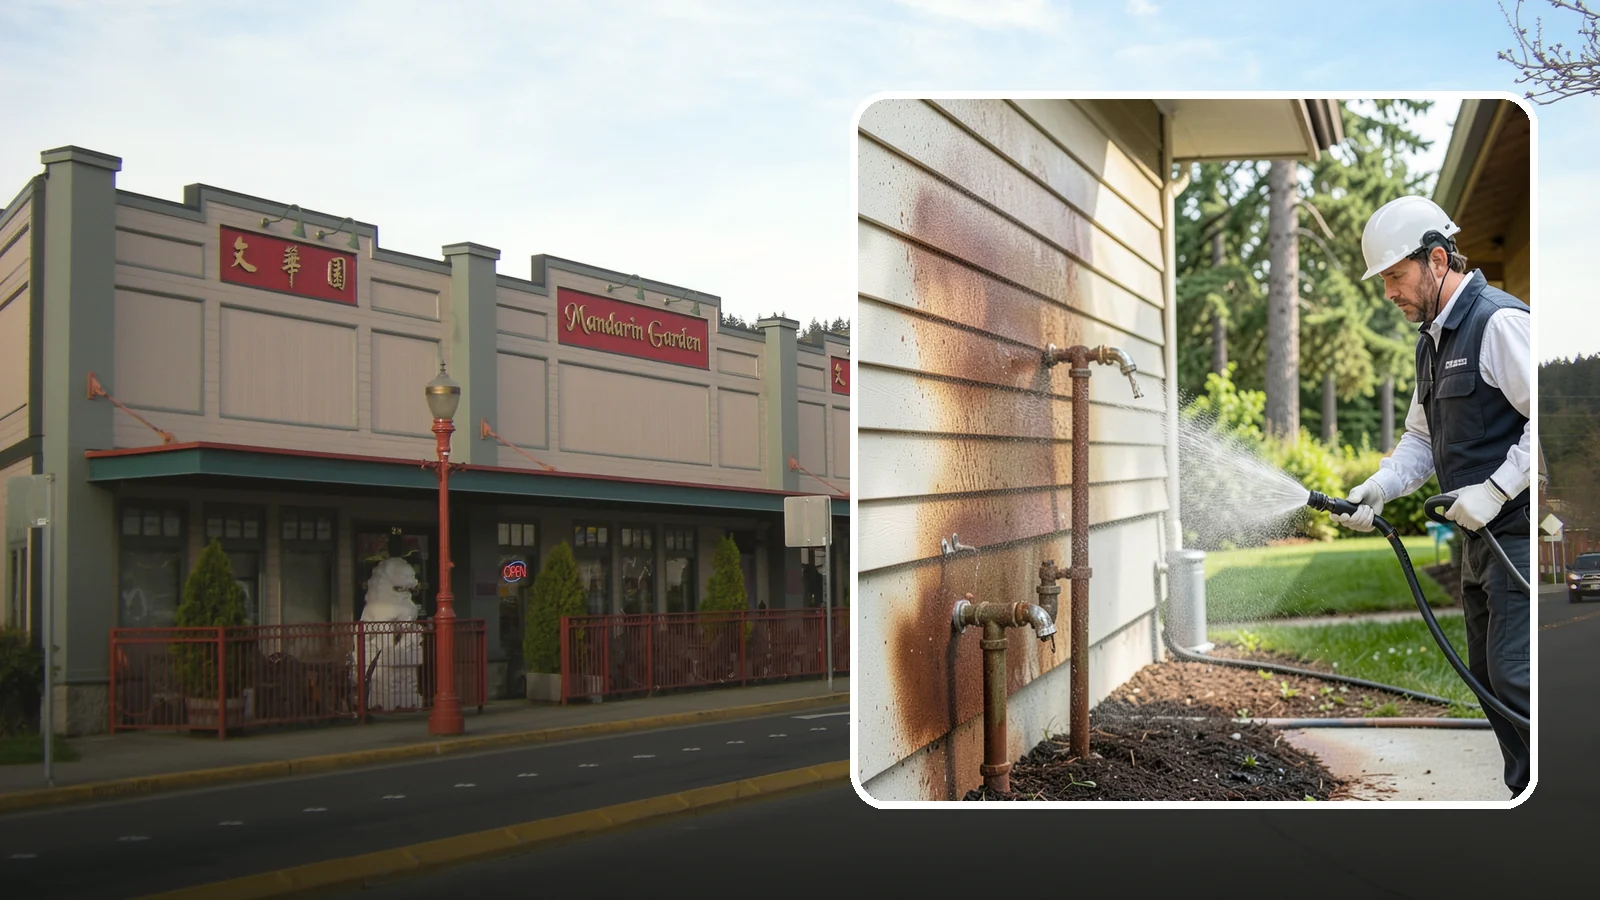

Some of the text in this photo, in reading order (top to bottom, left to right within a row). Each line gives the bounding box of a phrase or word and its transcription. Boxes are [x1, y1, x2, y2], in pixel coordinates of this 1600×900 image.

[230, 235, 346, 291] 文華園
[564, 302, 701, 352] Mandarin Garden
[503, 565, 527, 578] OPEN
